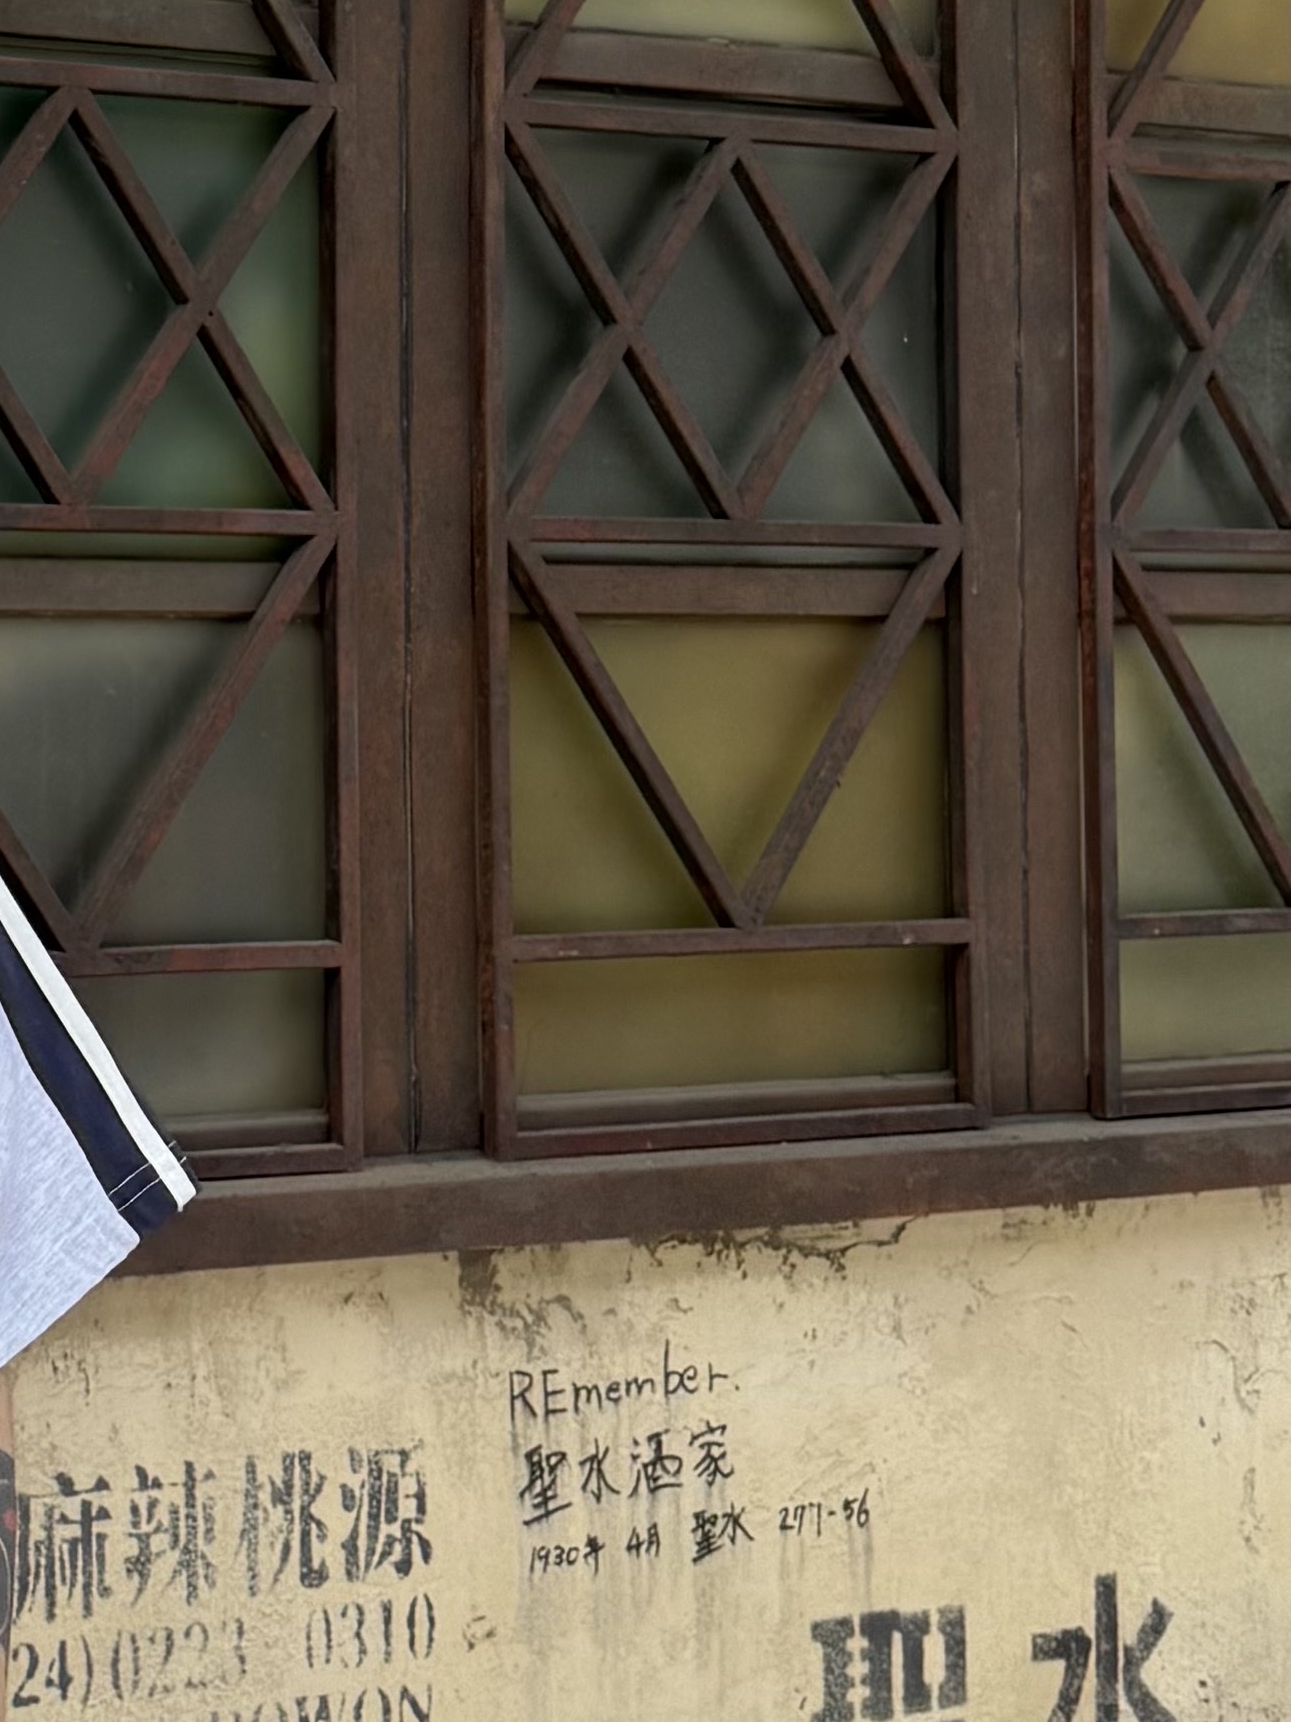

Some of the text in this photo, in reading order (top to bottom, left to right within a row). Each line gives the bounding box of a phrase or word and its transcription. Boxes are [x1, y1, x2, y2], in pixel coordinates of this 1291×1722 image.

[14, 1438, 435, 1625] 麻辣桃源
[304, 1592, 436, 1670] 0310
